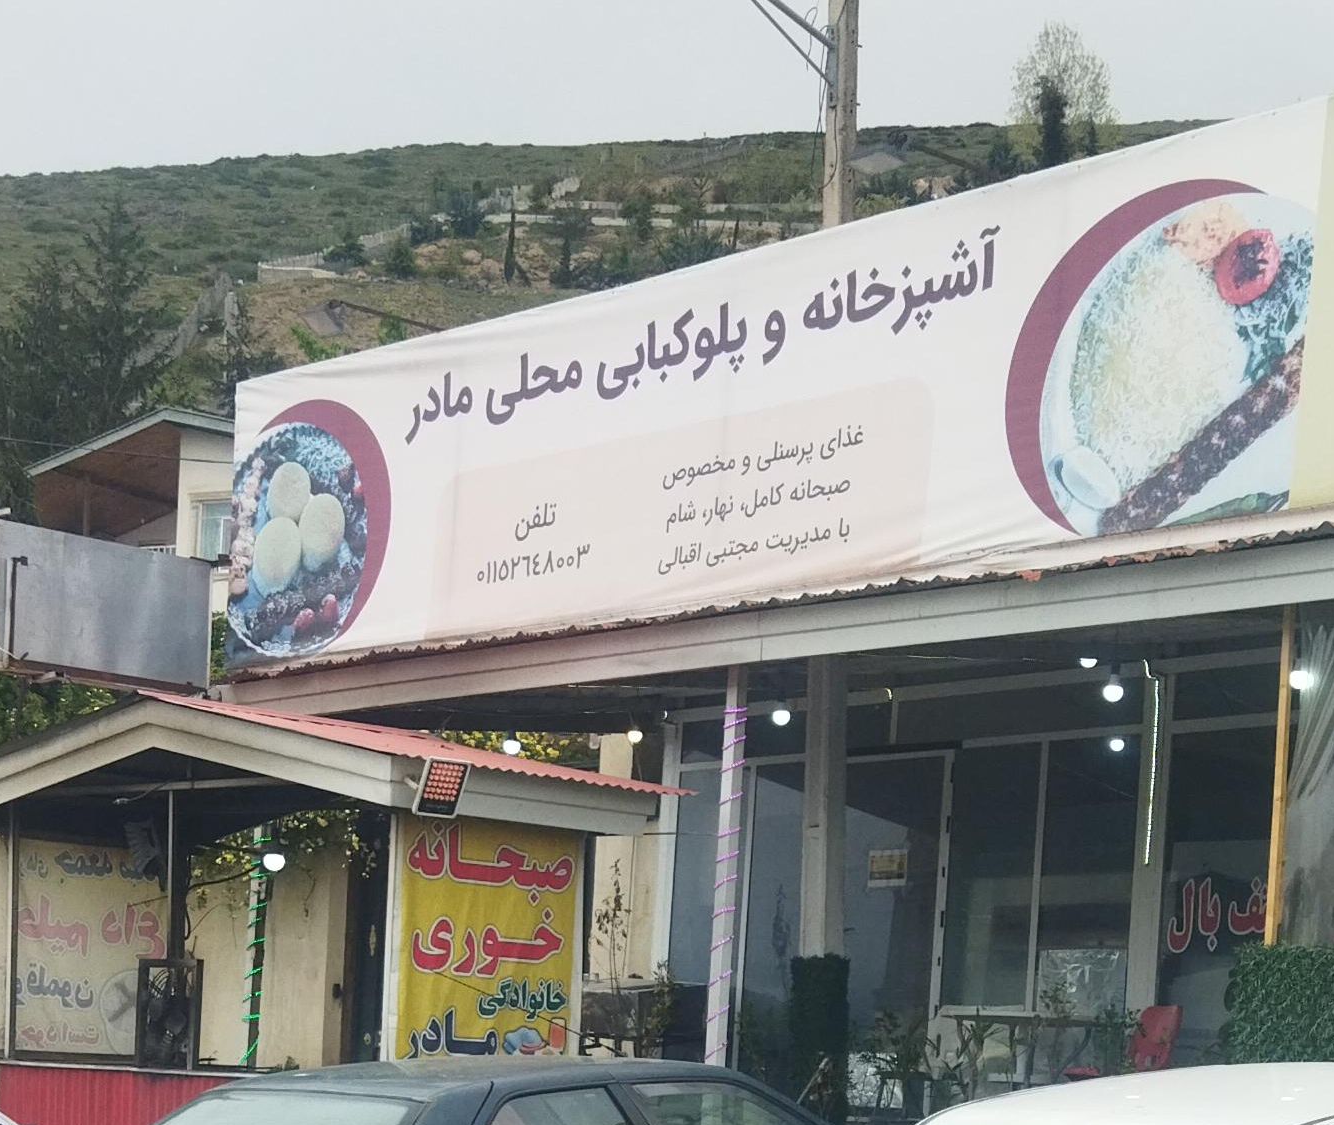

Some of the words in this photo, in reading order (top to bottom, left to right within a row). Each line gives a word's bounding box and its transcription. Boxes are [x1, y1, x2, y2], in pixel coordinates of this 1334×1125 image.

[802, 225, 1001, 335] آشپزخانه
[597, 302, 747, 400] پلوکبابی
[762, 309, 787, 365] و
[485, 353, 583, 425] محلی
[405, 372, 472, 448] مادر
[757, 441, 813, 472] پرسنلی
[821, 426, 864, 460] غذای
[662, 455, 735, 490] مخصوص
[742, 455, 751, 474] و
[790, 478, 850, 503] صبحانه
[514, 502, 556, 541] تلفن
[666, 502, 695, 533] شام
[839, 518, 850, 543] با
[706, 539, 759, 568] مجتبی
[765, 529, 831, 554] مدیریت
[658, 547, 702, 576] اقبالی
[408, 821, 574, 906] صبحانه
[1167, 876, 1221, 953] بال
[412, 907, 564, 977] خوری
[478, 977, 569, 1020] خانوادگی
[406, 1007, 498, 1059] مادر
